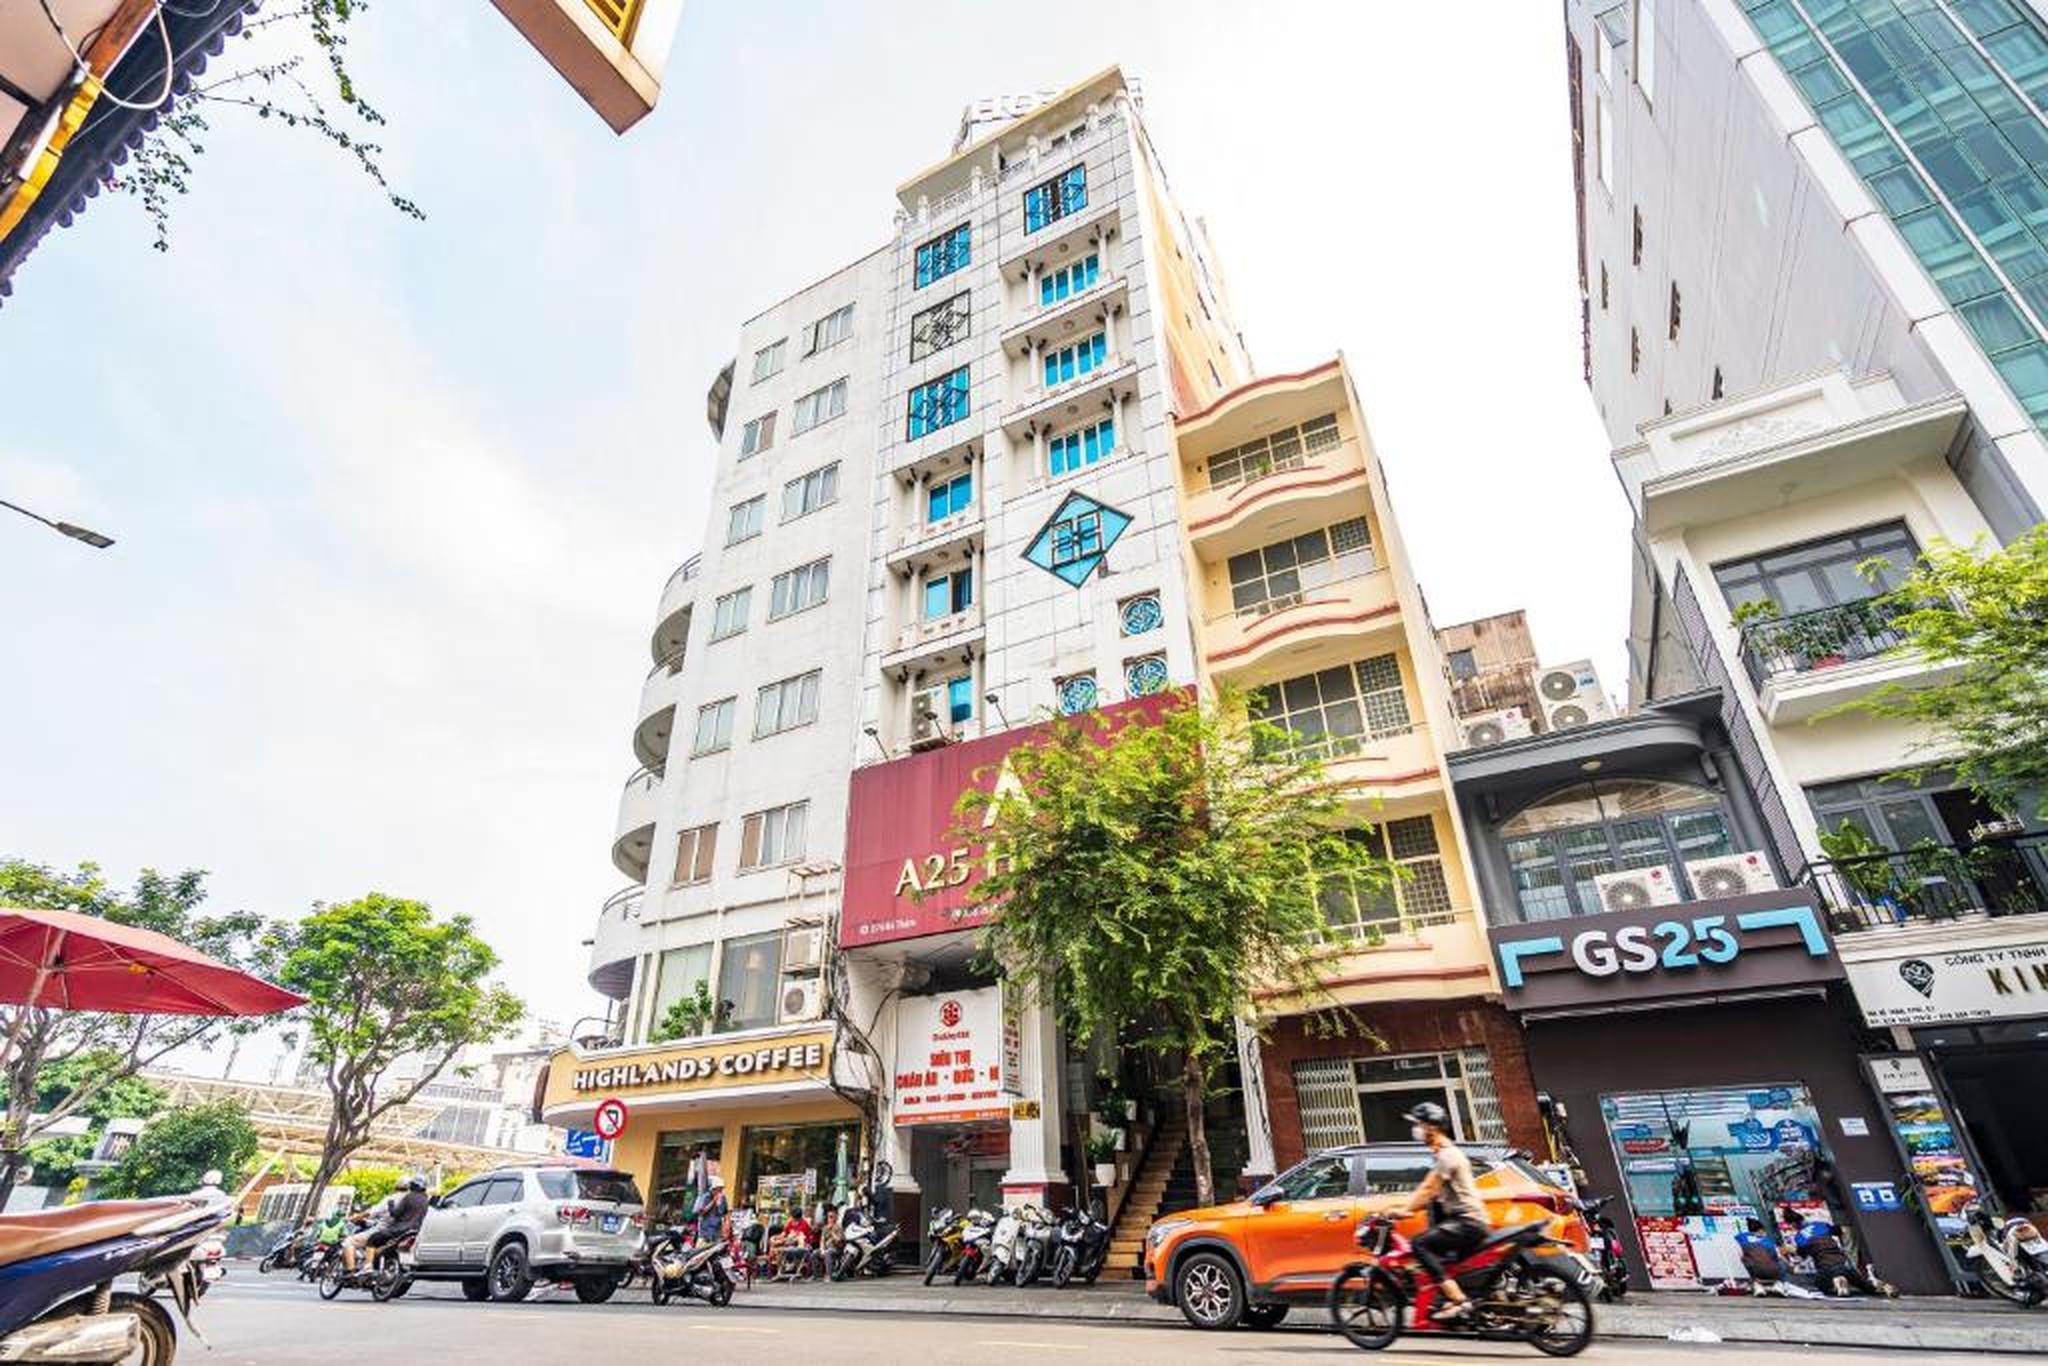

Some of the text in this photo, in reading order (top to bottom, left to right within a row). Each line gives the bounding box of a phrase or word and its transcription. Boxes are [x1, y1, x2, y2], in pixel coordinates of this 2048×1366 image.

[895, 849, 969, 897] A25
[1571, 915, 1740, 978] GS25
[1944, 953, 1985, 967] CÔNG
[1987, 951, 2004, 962] TY
[572, 1044, 823, 1091] HIGHLANDS COFFEE
